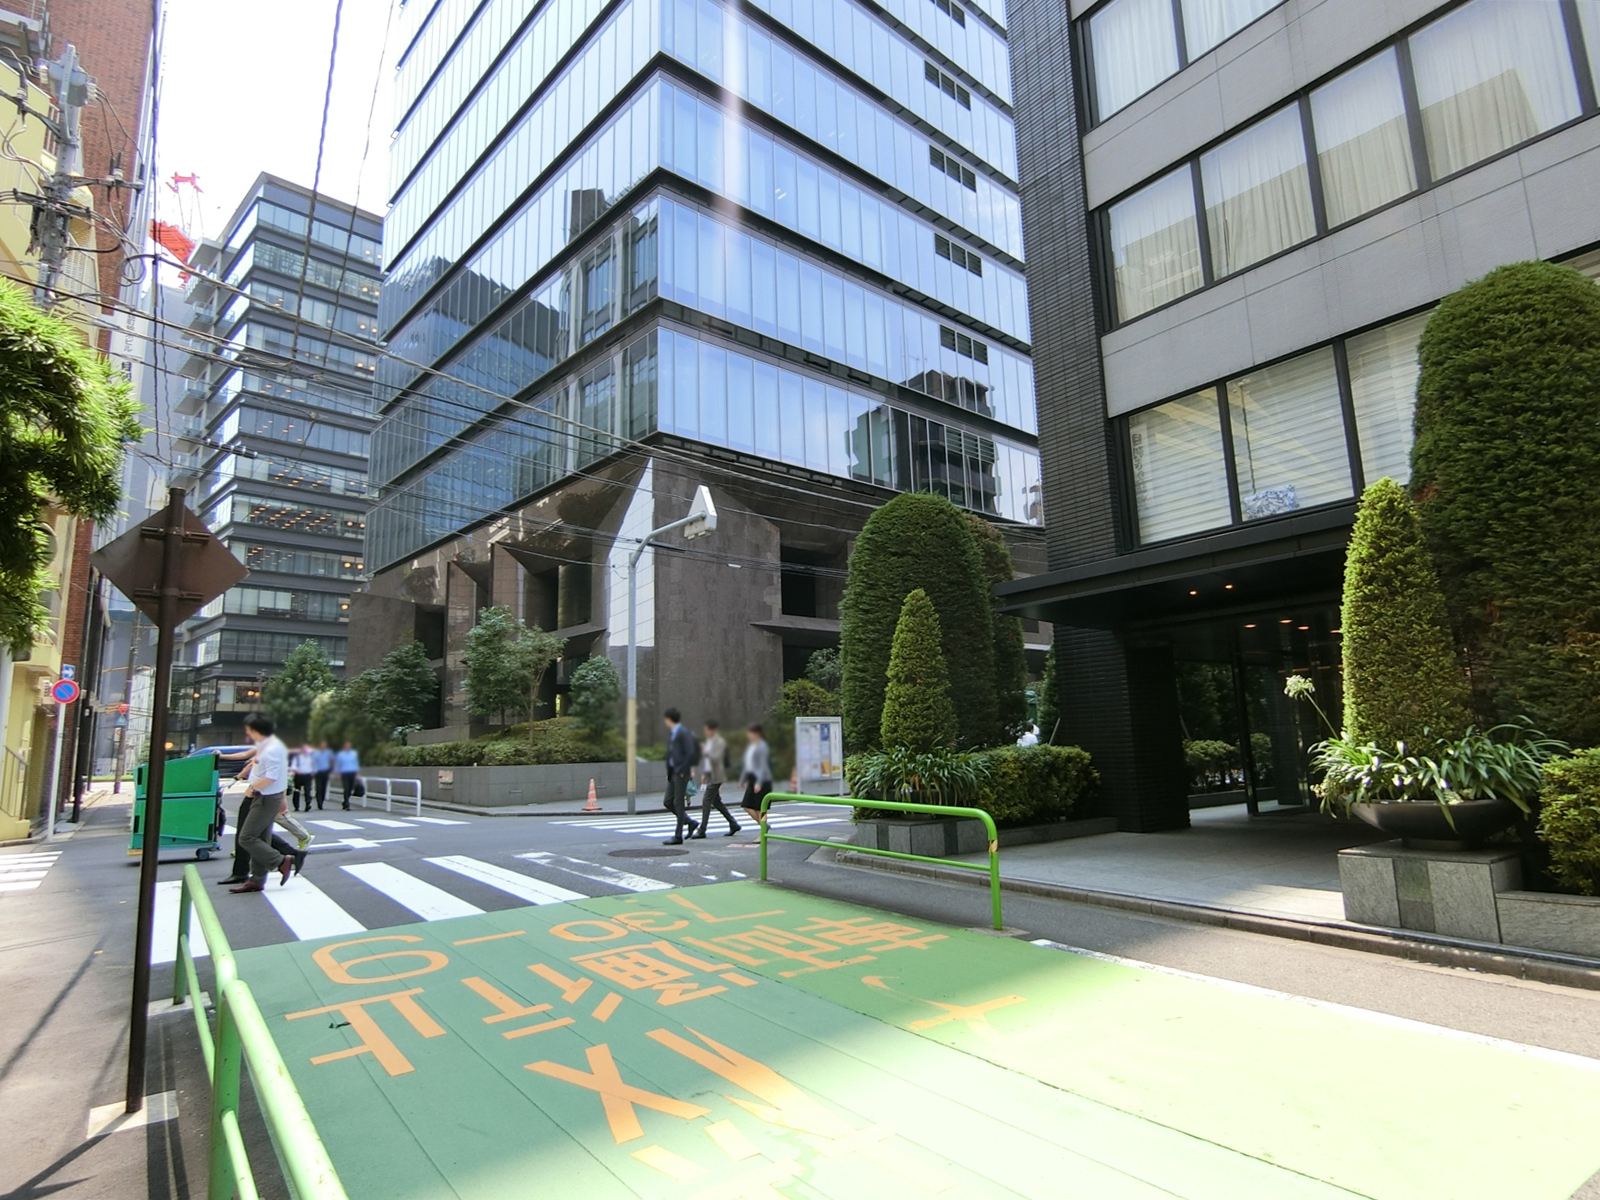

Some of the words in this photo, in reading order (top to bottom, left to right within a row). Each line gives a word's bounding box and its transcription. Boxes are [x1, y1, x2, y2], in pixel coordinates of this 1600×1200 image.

[284, 916, 950, 1077] 車両通行止
